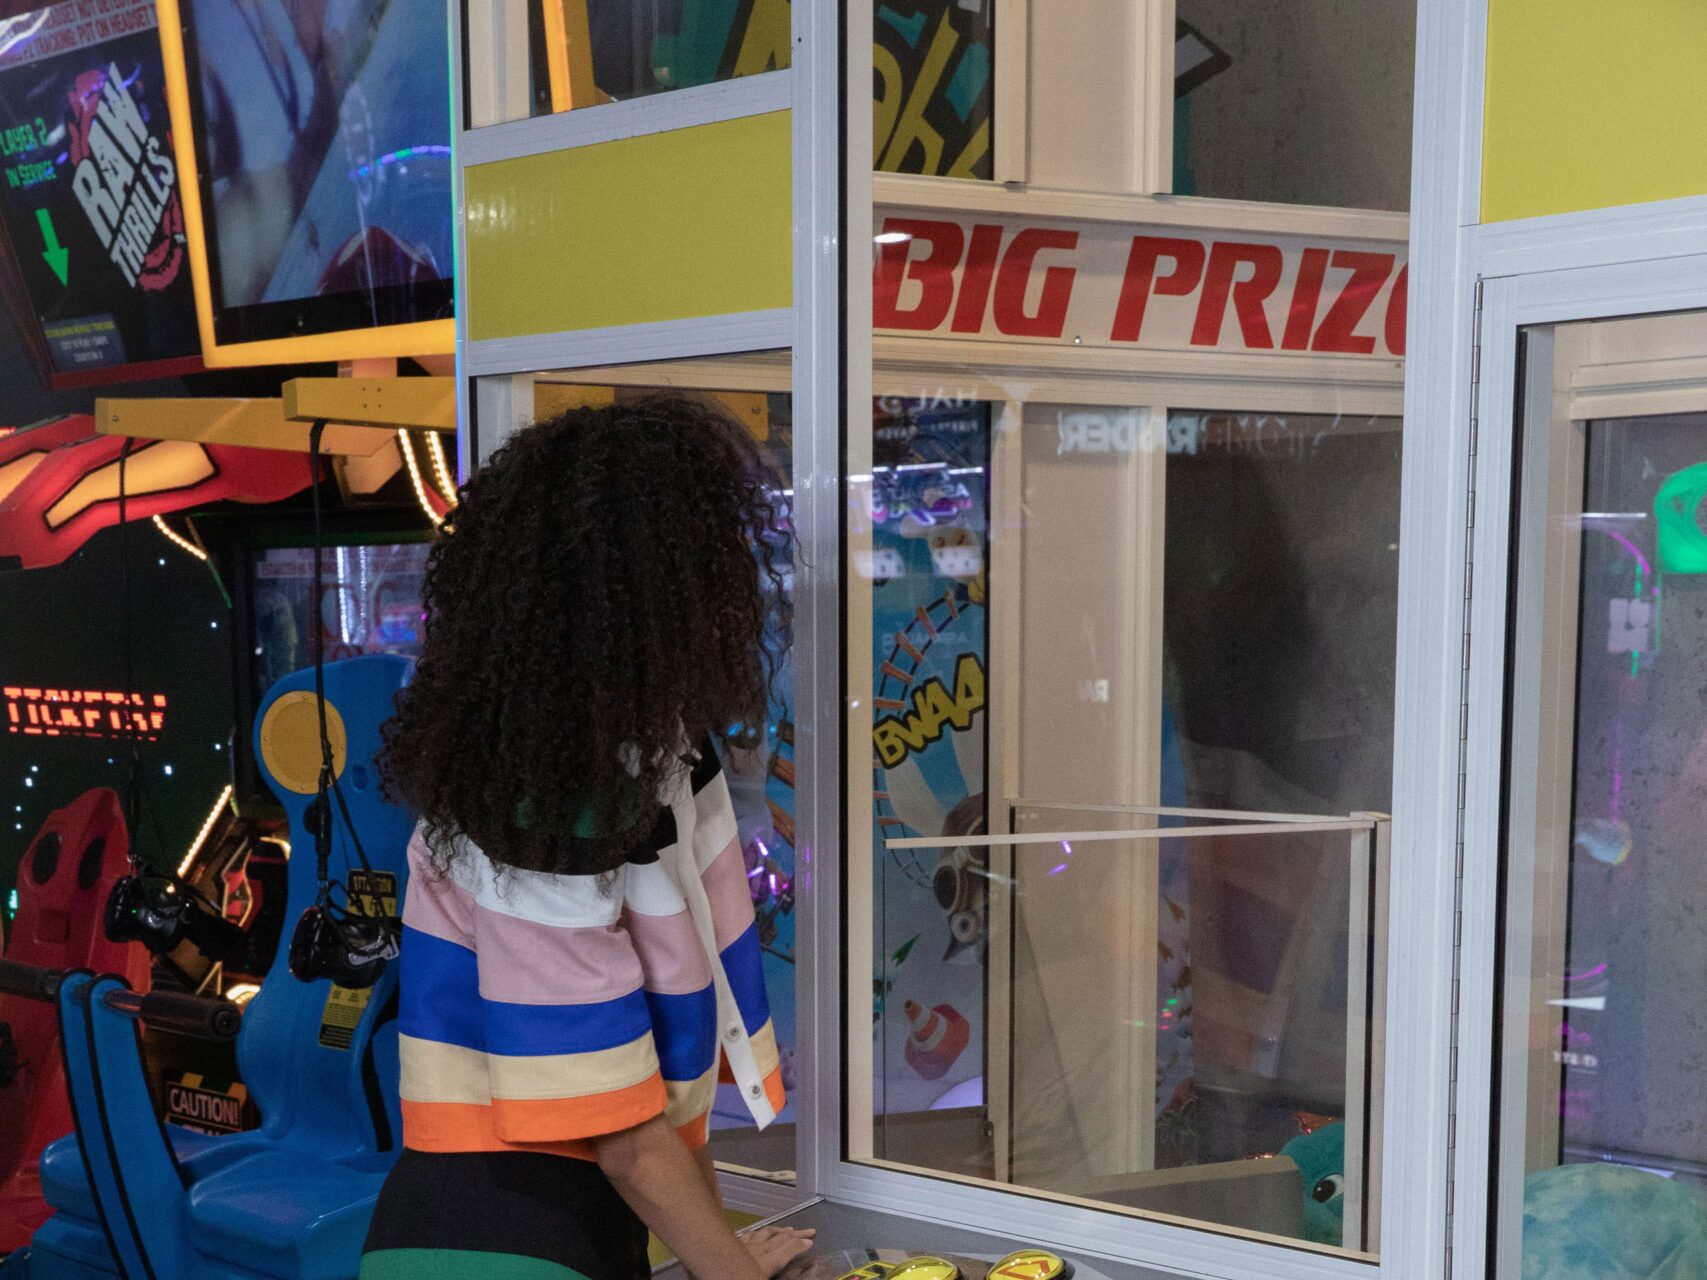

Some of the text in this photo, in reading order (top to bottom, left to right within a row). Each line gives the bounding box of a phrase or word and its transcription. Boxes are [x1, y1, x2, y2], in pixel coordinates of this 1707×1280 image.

[72, 61, 149, 250] RAW
[110, 136, 175, 288] THRILLS
[872, 217, 1079, 338] BIG
[170, 1088, 239, 1126] CAUTION!
